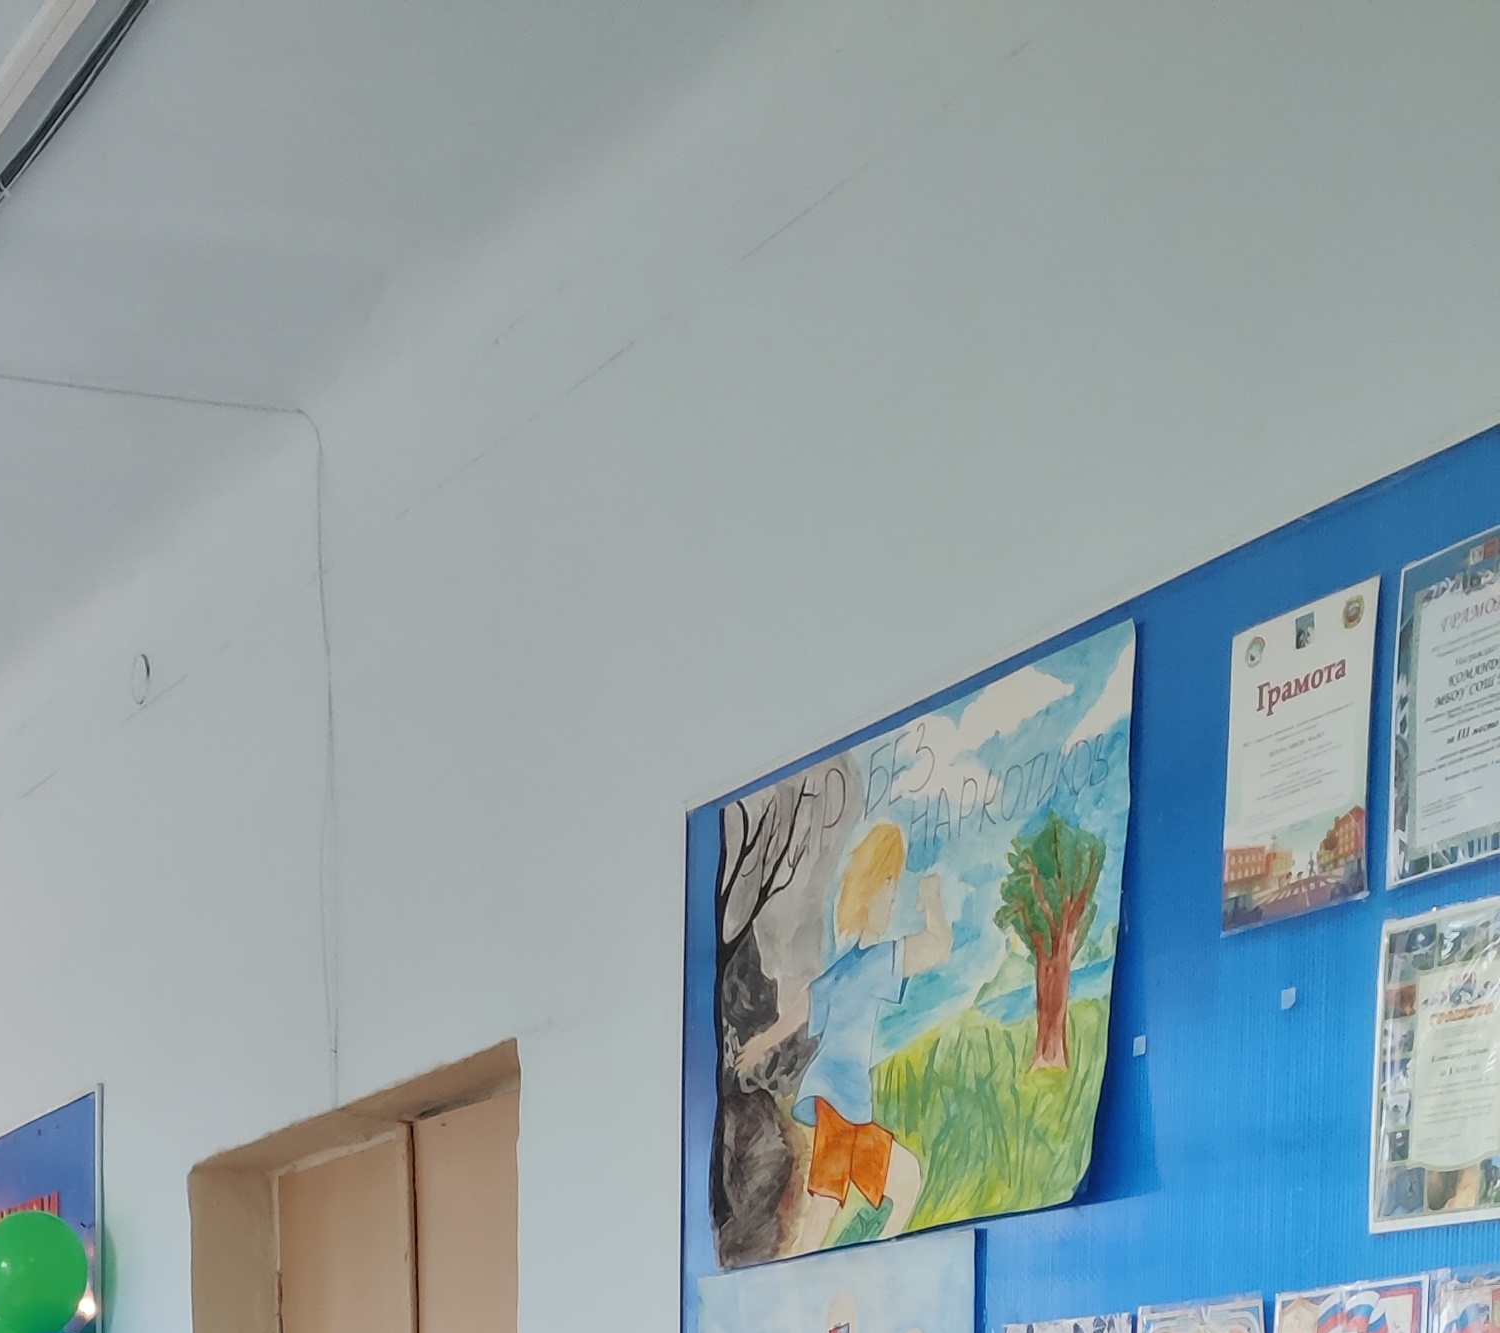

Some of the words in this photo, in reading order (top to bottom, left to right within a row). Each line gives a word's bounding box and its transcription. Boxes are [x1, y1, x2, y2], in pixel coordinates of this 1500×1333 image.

[1256, 658, 1346, 717] Грамота
[864, 722, 936, 820] БЕЗ
[908, 733, 1110, 852] НАРКОТИКОВ
